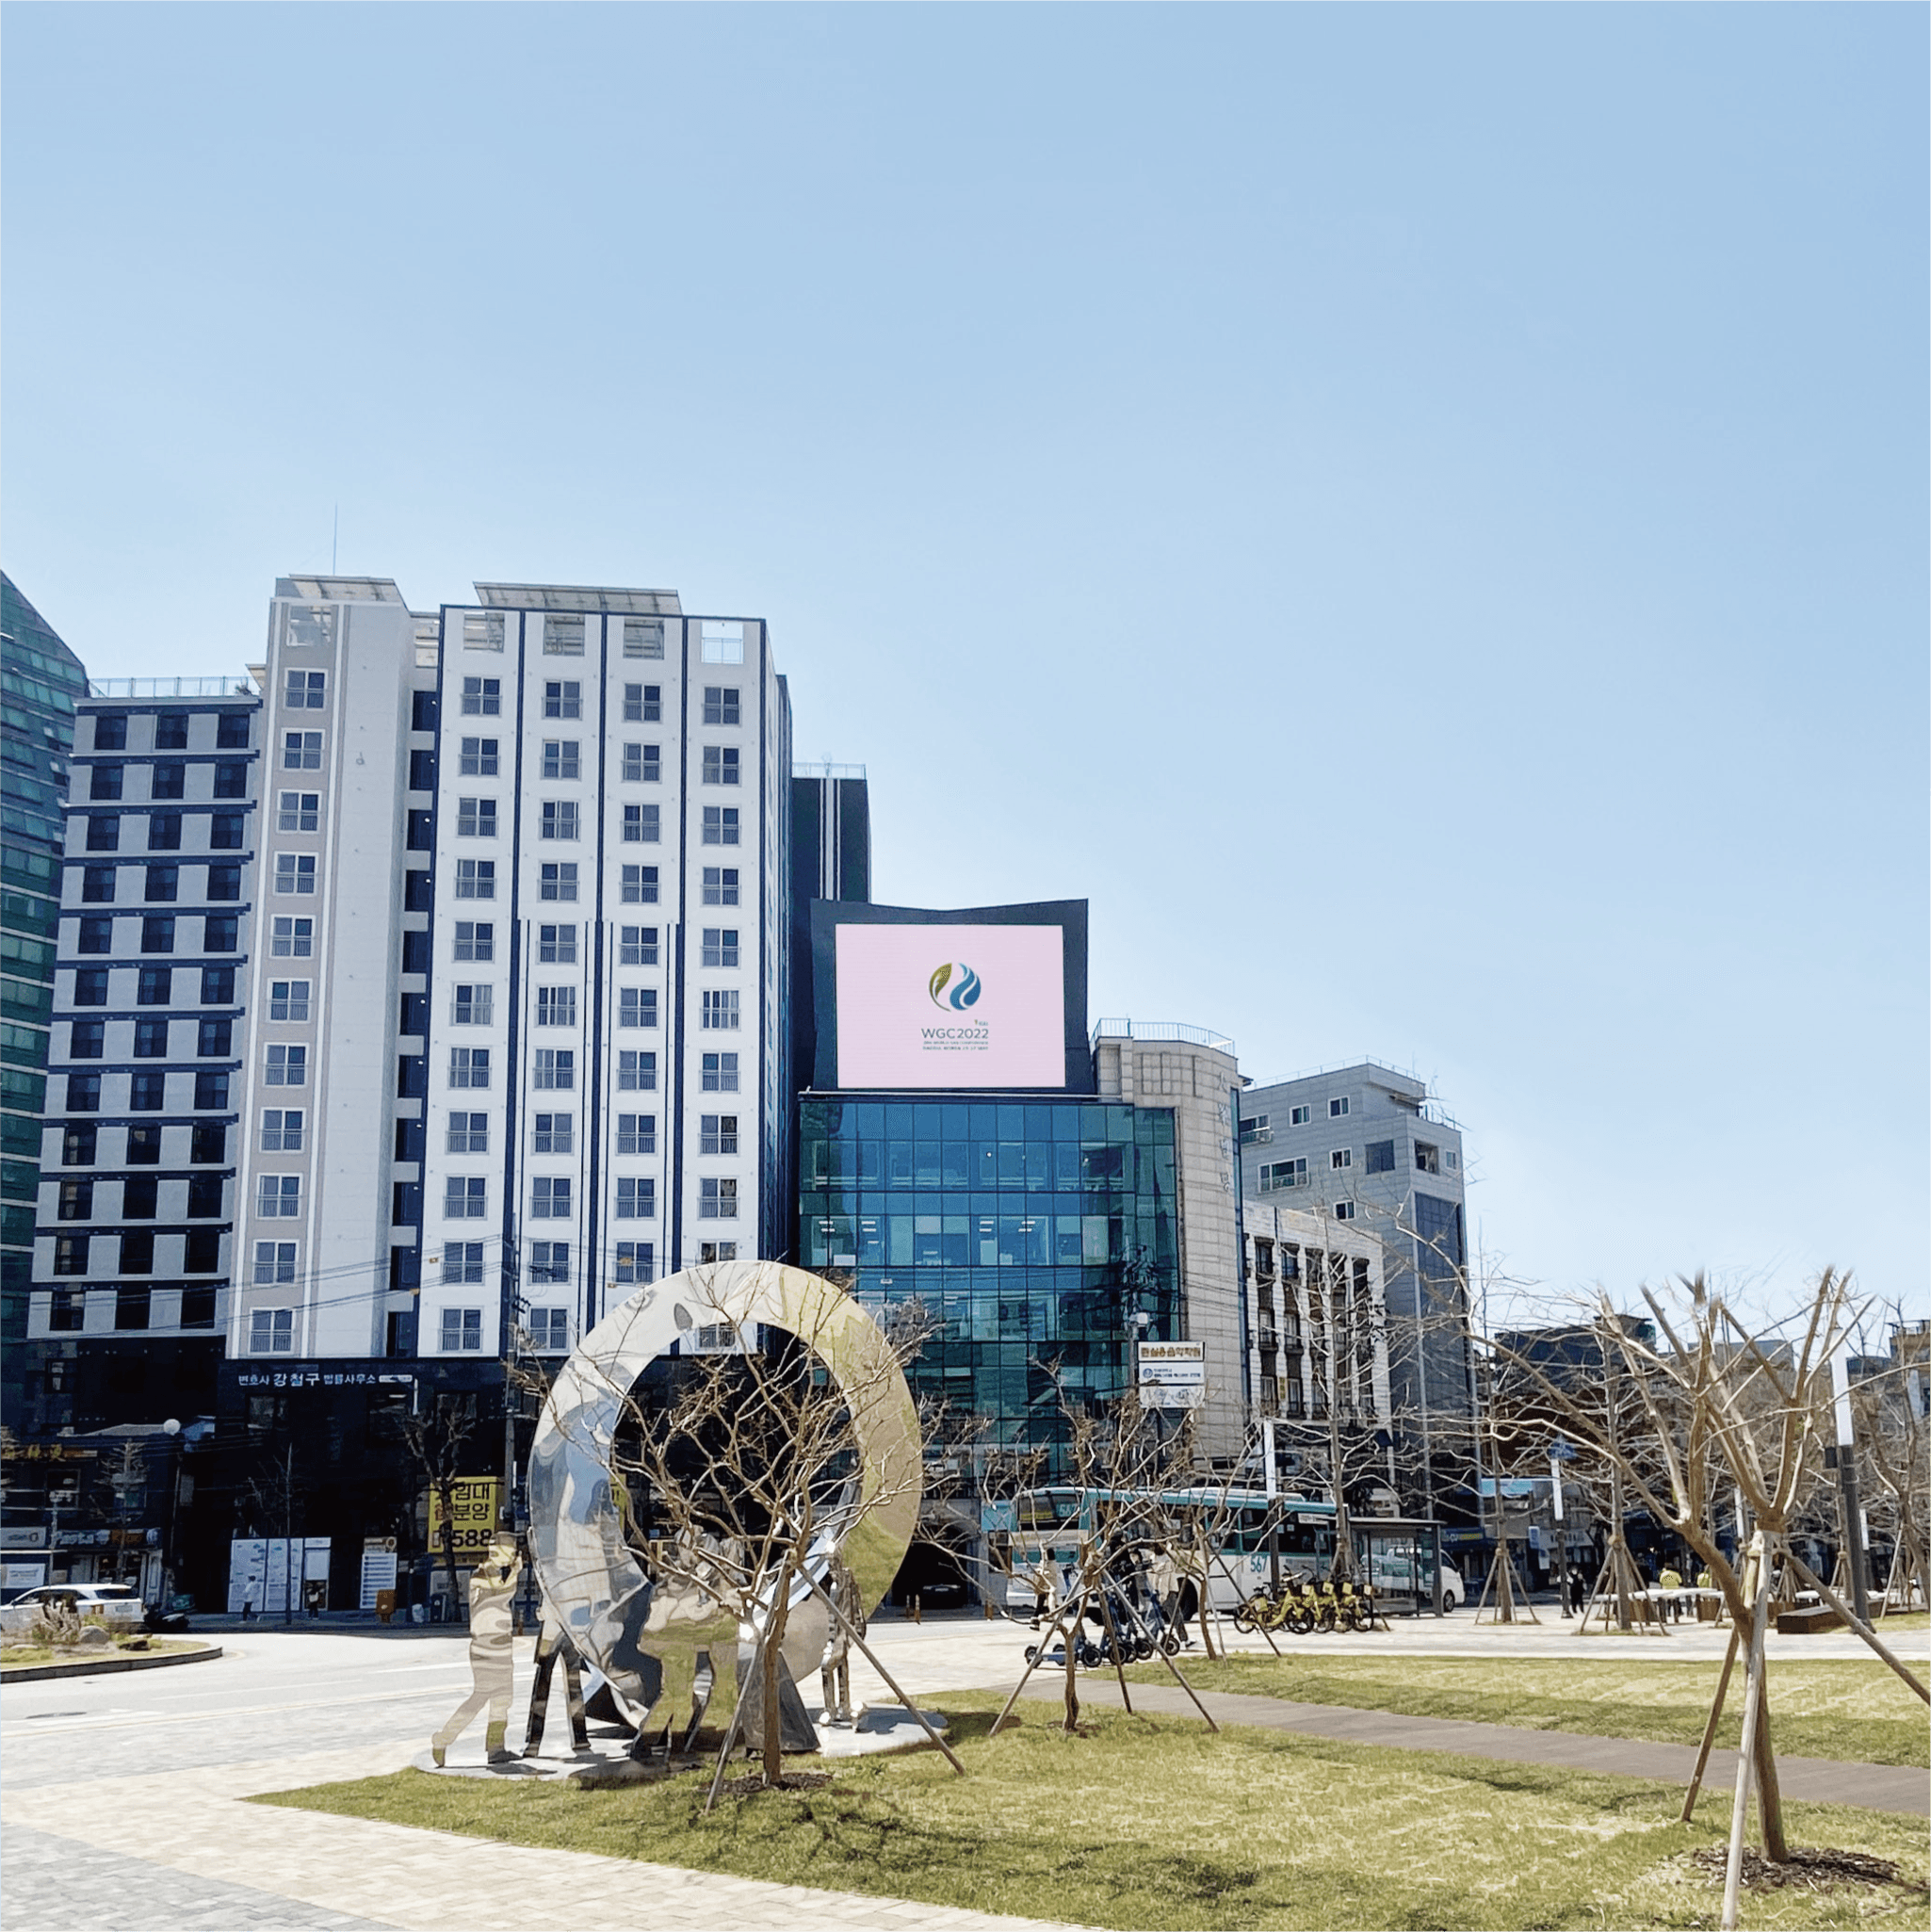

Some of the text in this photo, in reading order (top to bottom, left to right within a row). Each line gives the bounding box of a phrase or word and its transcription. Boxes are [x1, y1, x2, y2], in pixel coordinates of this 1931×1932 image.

[921, 1028, 989, 1040] WGC2022
[238, 1374, 270, 1386] 변호사
[1250, 1555, 1268, 1573] 567
